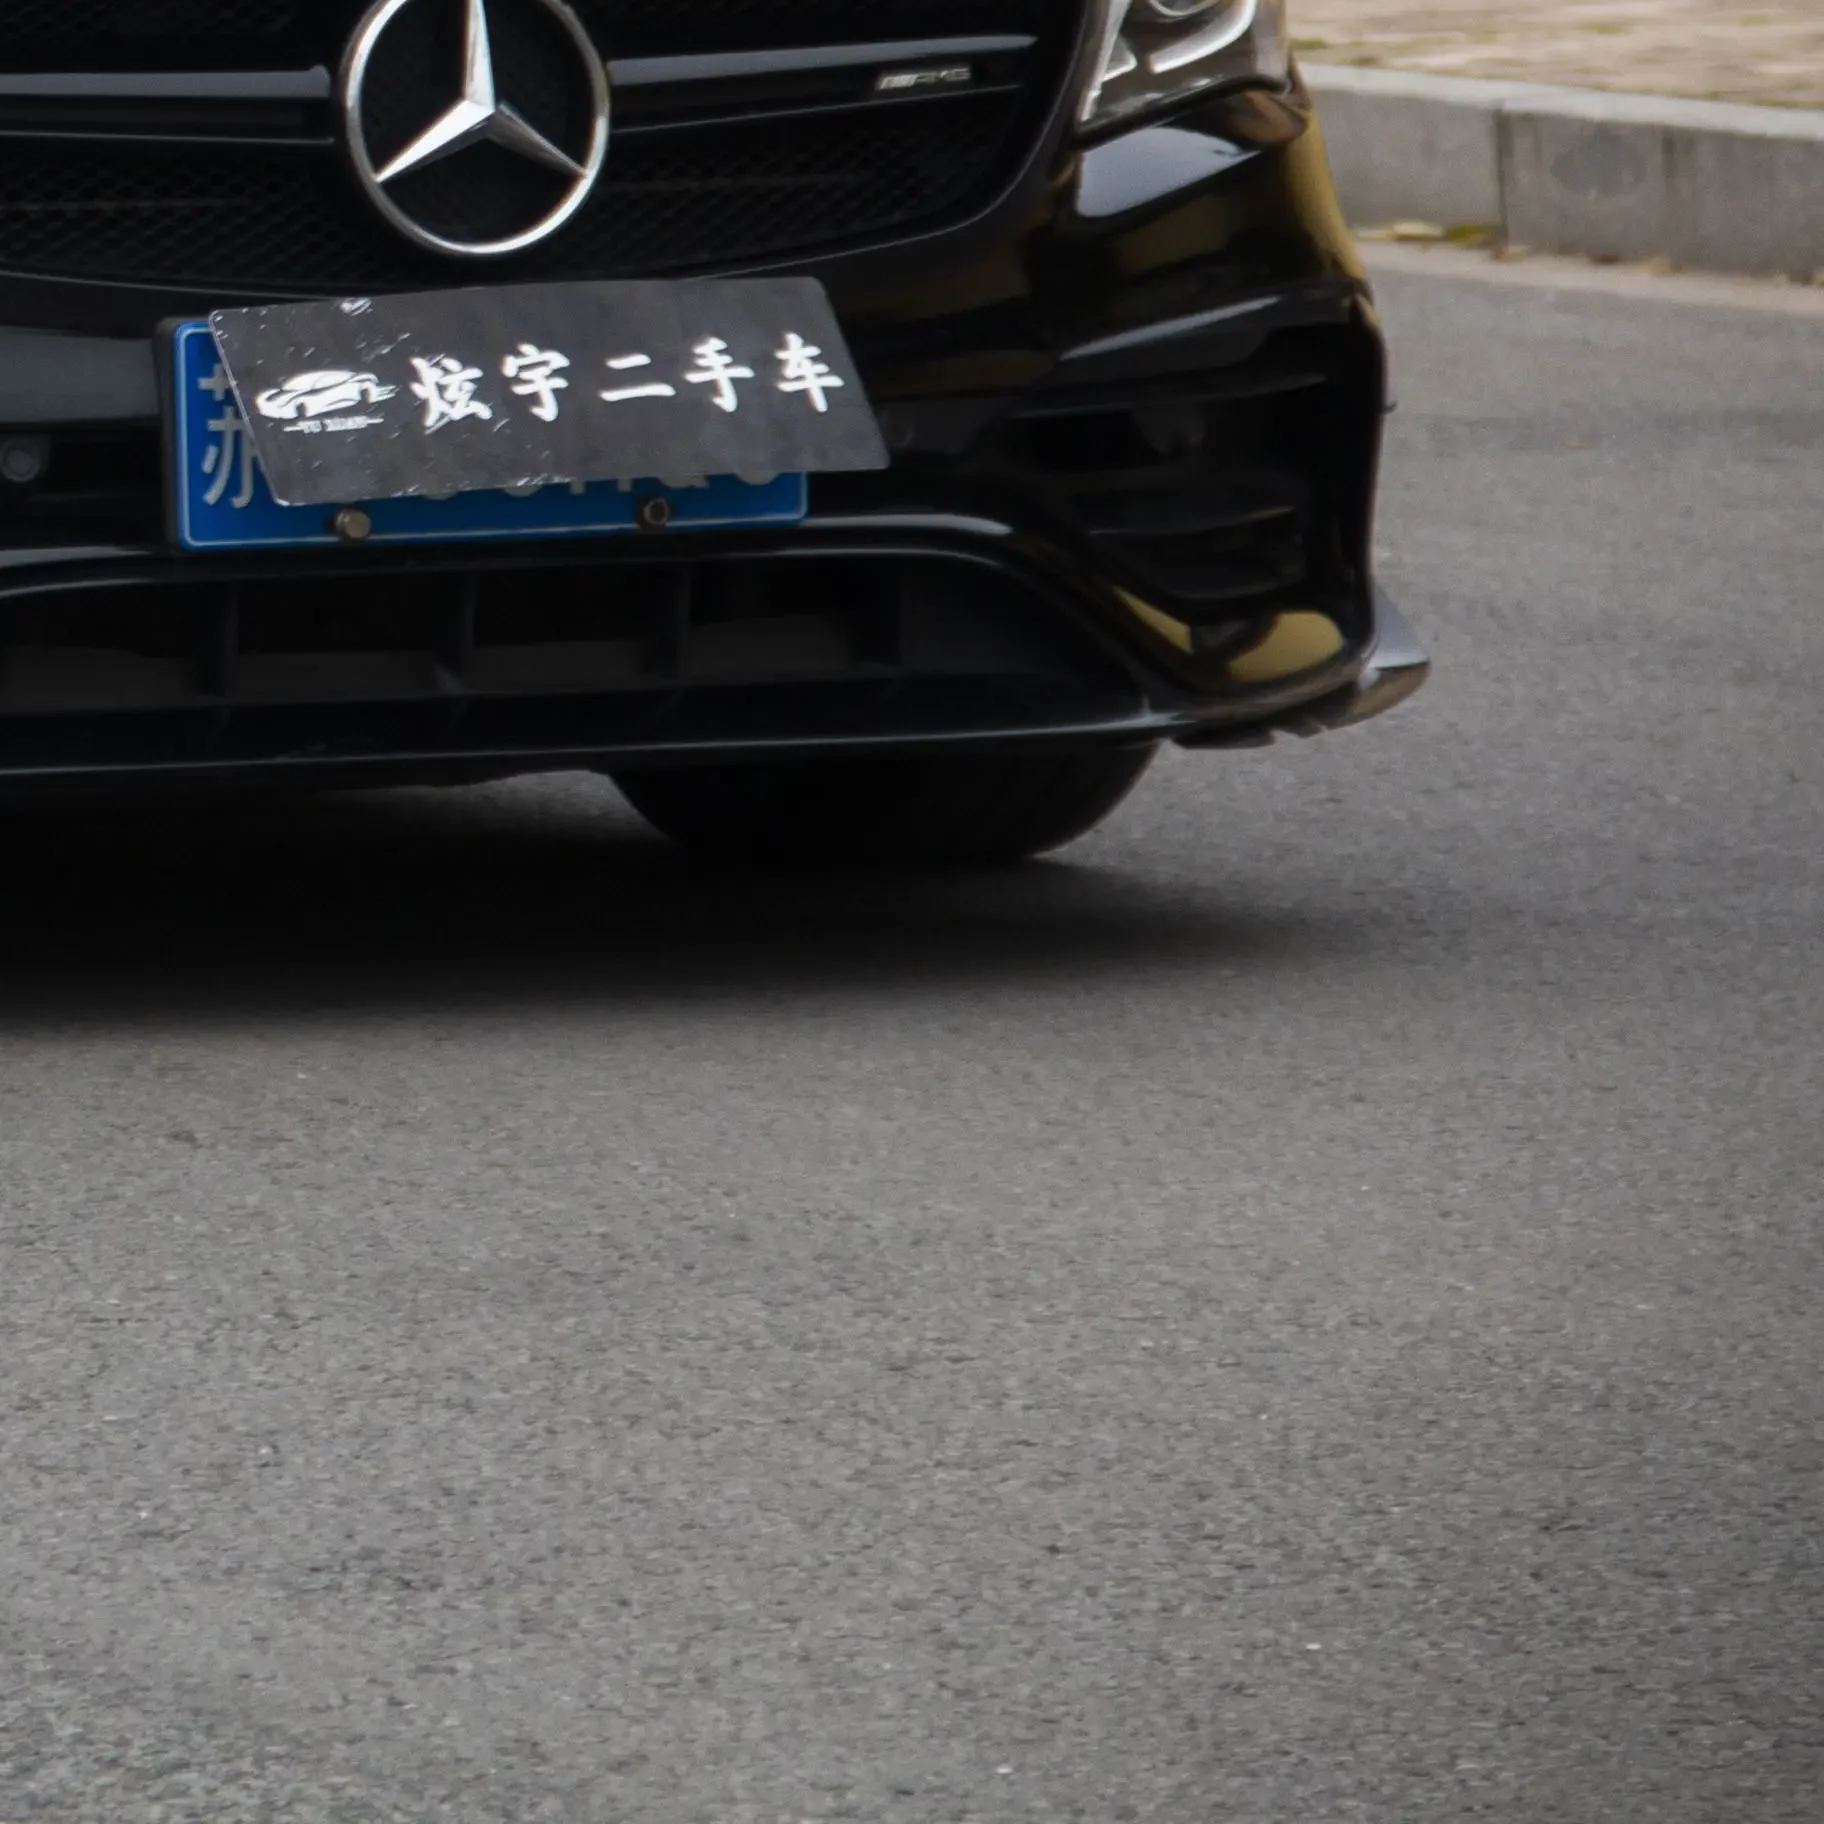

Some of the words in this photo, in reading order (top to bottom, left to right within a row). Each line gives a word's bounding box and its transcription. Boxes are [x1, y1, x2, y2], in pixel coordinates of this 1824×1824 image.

[410, 332, 844, 430] 炫宇二手车
